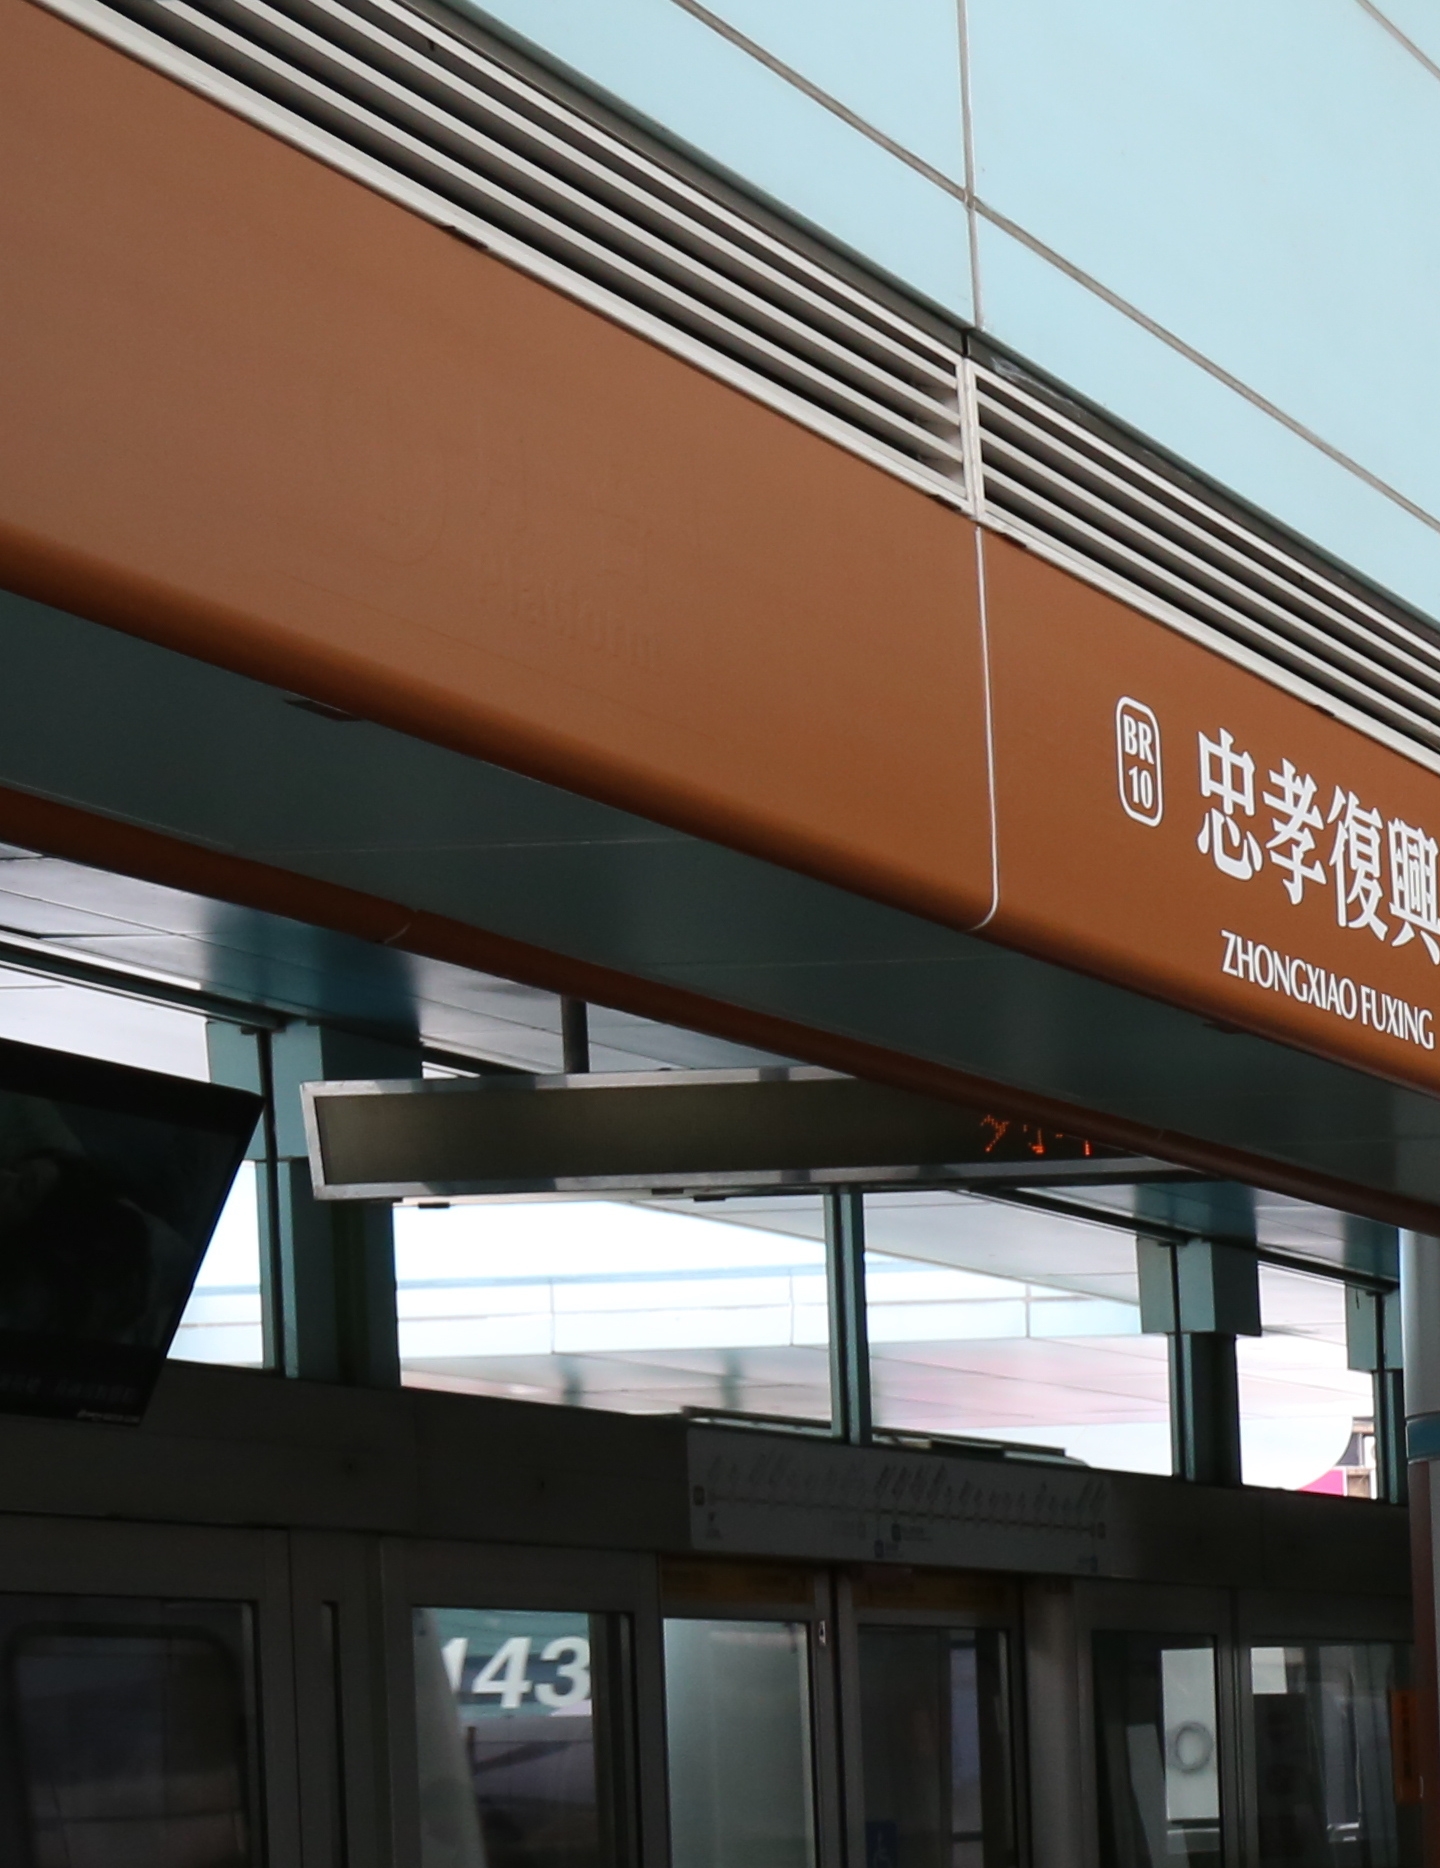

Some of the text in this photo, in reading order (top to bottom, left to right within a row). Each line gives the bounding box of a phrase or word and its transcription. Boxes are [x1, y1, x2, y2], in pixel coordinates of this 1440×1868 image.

[1123, 715, 1153, 764] BR
[1128, 767, 1153, 808] 10
[1221, 930, 1435, 1049] ZHONGXIAO FUXING
